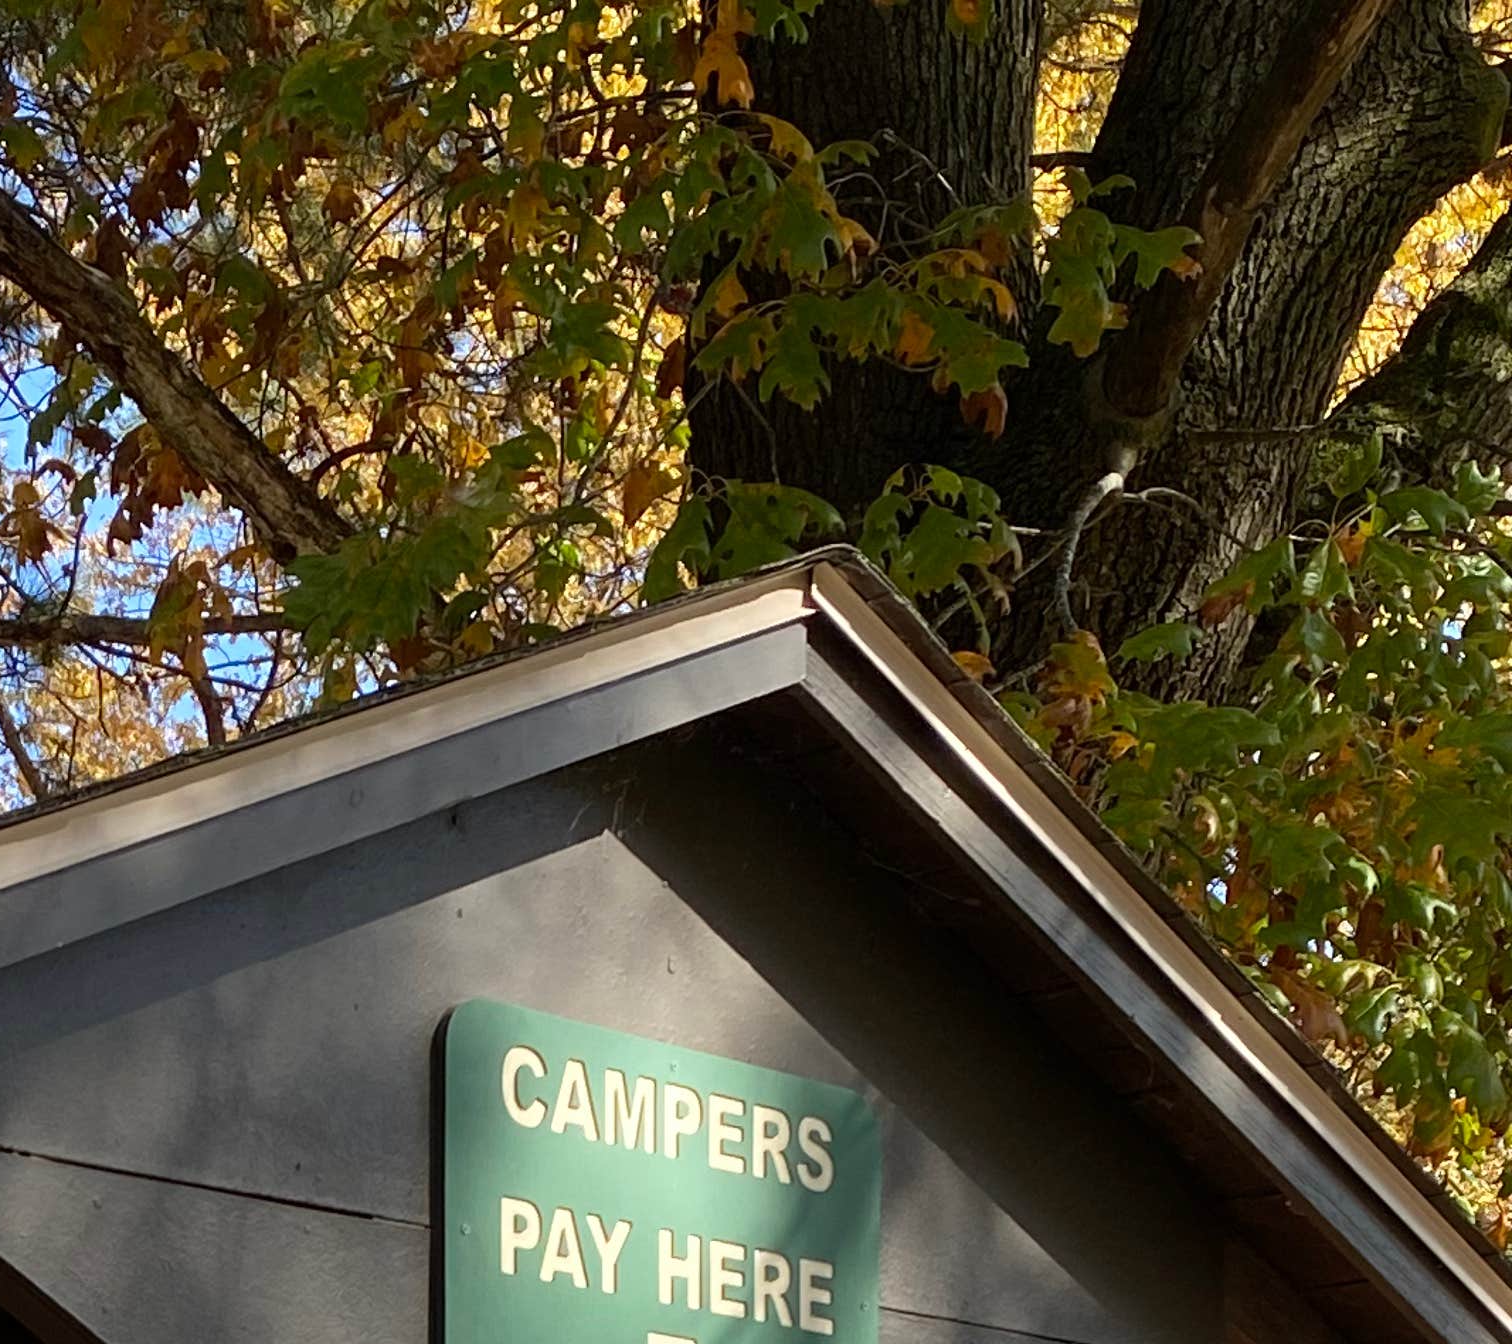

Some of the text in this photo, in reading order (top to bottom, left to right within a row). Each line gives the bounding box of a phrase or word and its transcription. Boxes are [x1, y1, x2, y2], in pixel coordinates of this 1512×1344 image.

[501, 1045, 834, 1192] CAMPERS
[500, 1197, 834, 1335] PAY HERE
